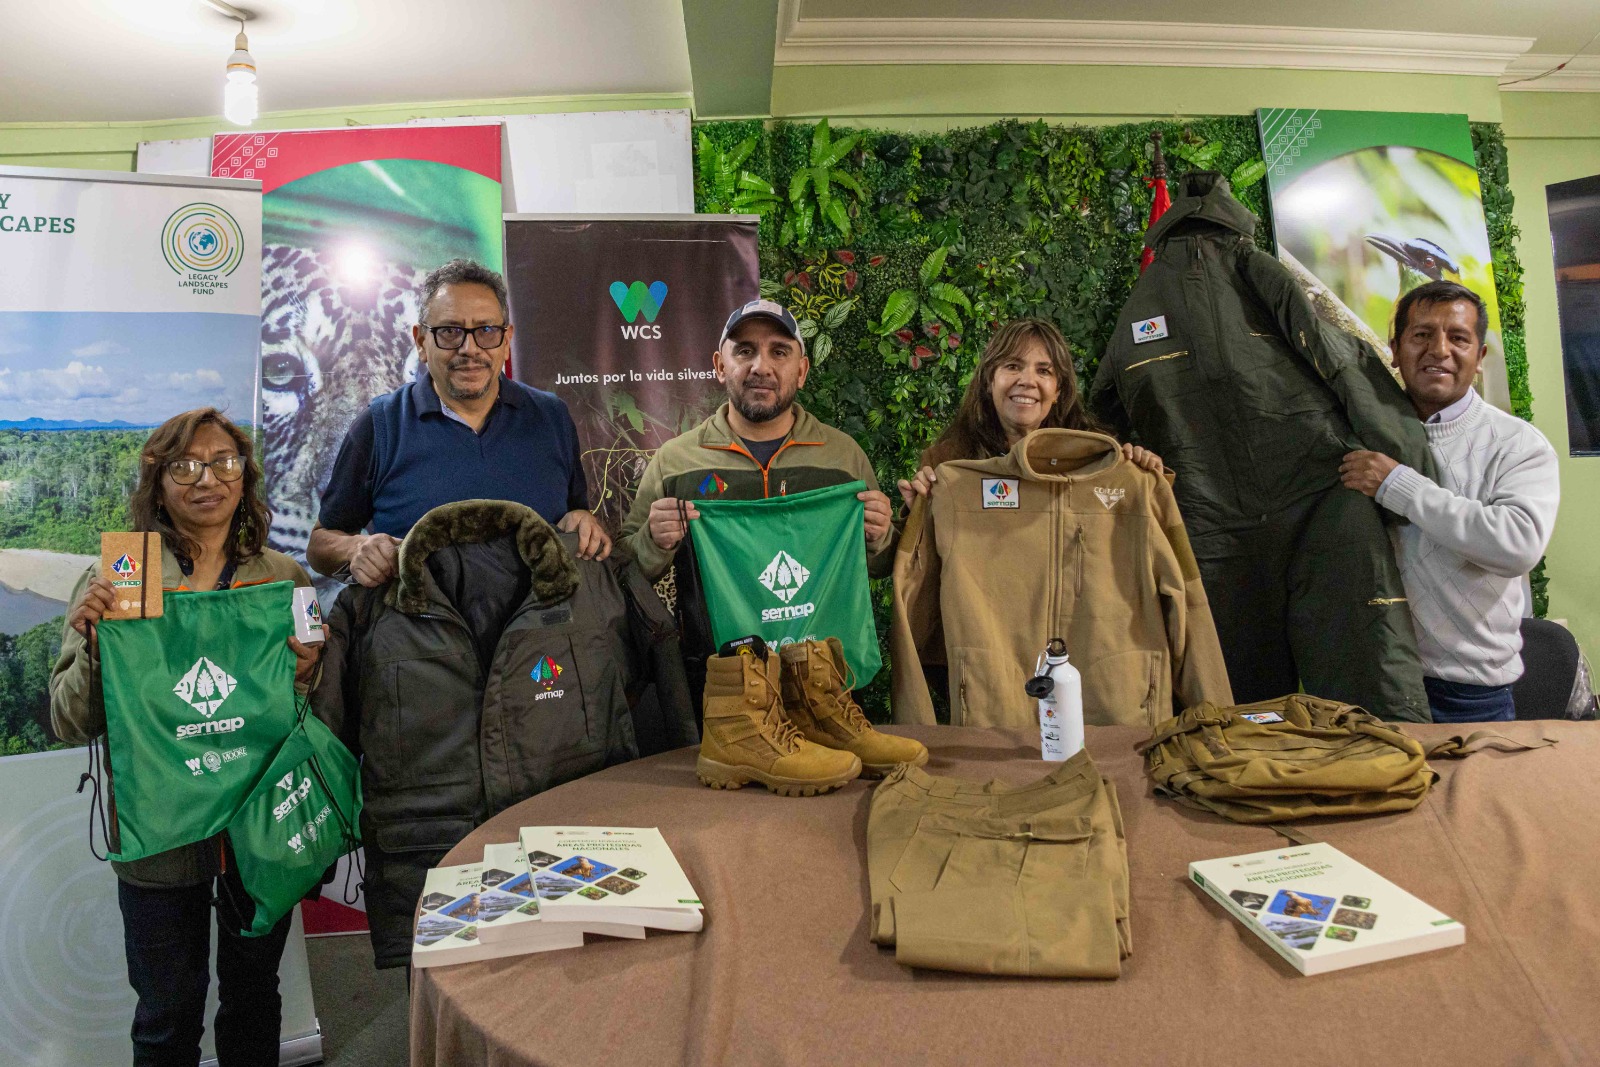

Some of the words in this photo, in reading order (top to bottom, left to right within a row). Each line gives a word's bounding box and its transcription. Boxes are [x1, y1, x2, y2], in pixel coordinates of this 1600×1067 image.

[188, 273, 218, 281] LEGACY
[178, 280, 229, 289] LANDSCAPES
[620, 325, 662, 340] WCS
[555, 373, 599, 385] Juntos
[603, 372, 626, 386] por
[630, 369, 642, 382] la
[646, 369, 674, 381] vida
[762, 602, 814, 620] sernap
[535, 689, 564, 700] sernap
[176, 716, 245, 737] sernap
[272, 777, 312, 821] sernap
[1266, 871, 1325, 884] NACIONALES
[1275, 864, 1333, 877] PROTEGIDAS
